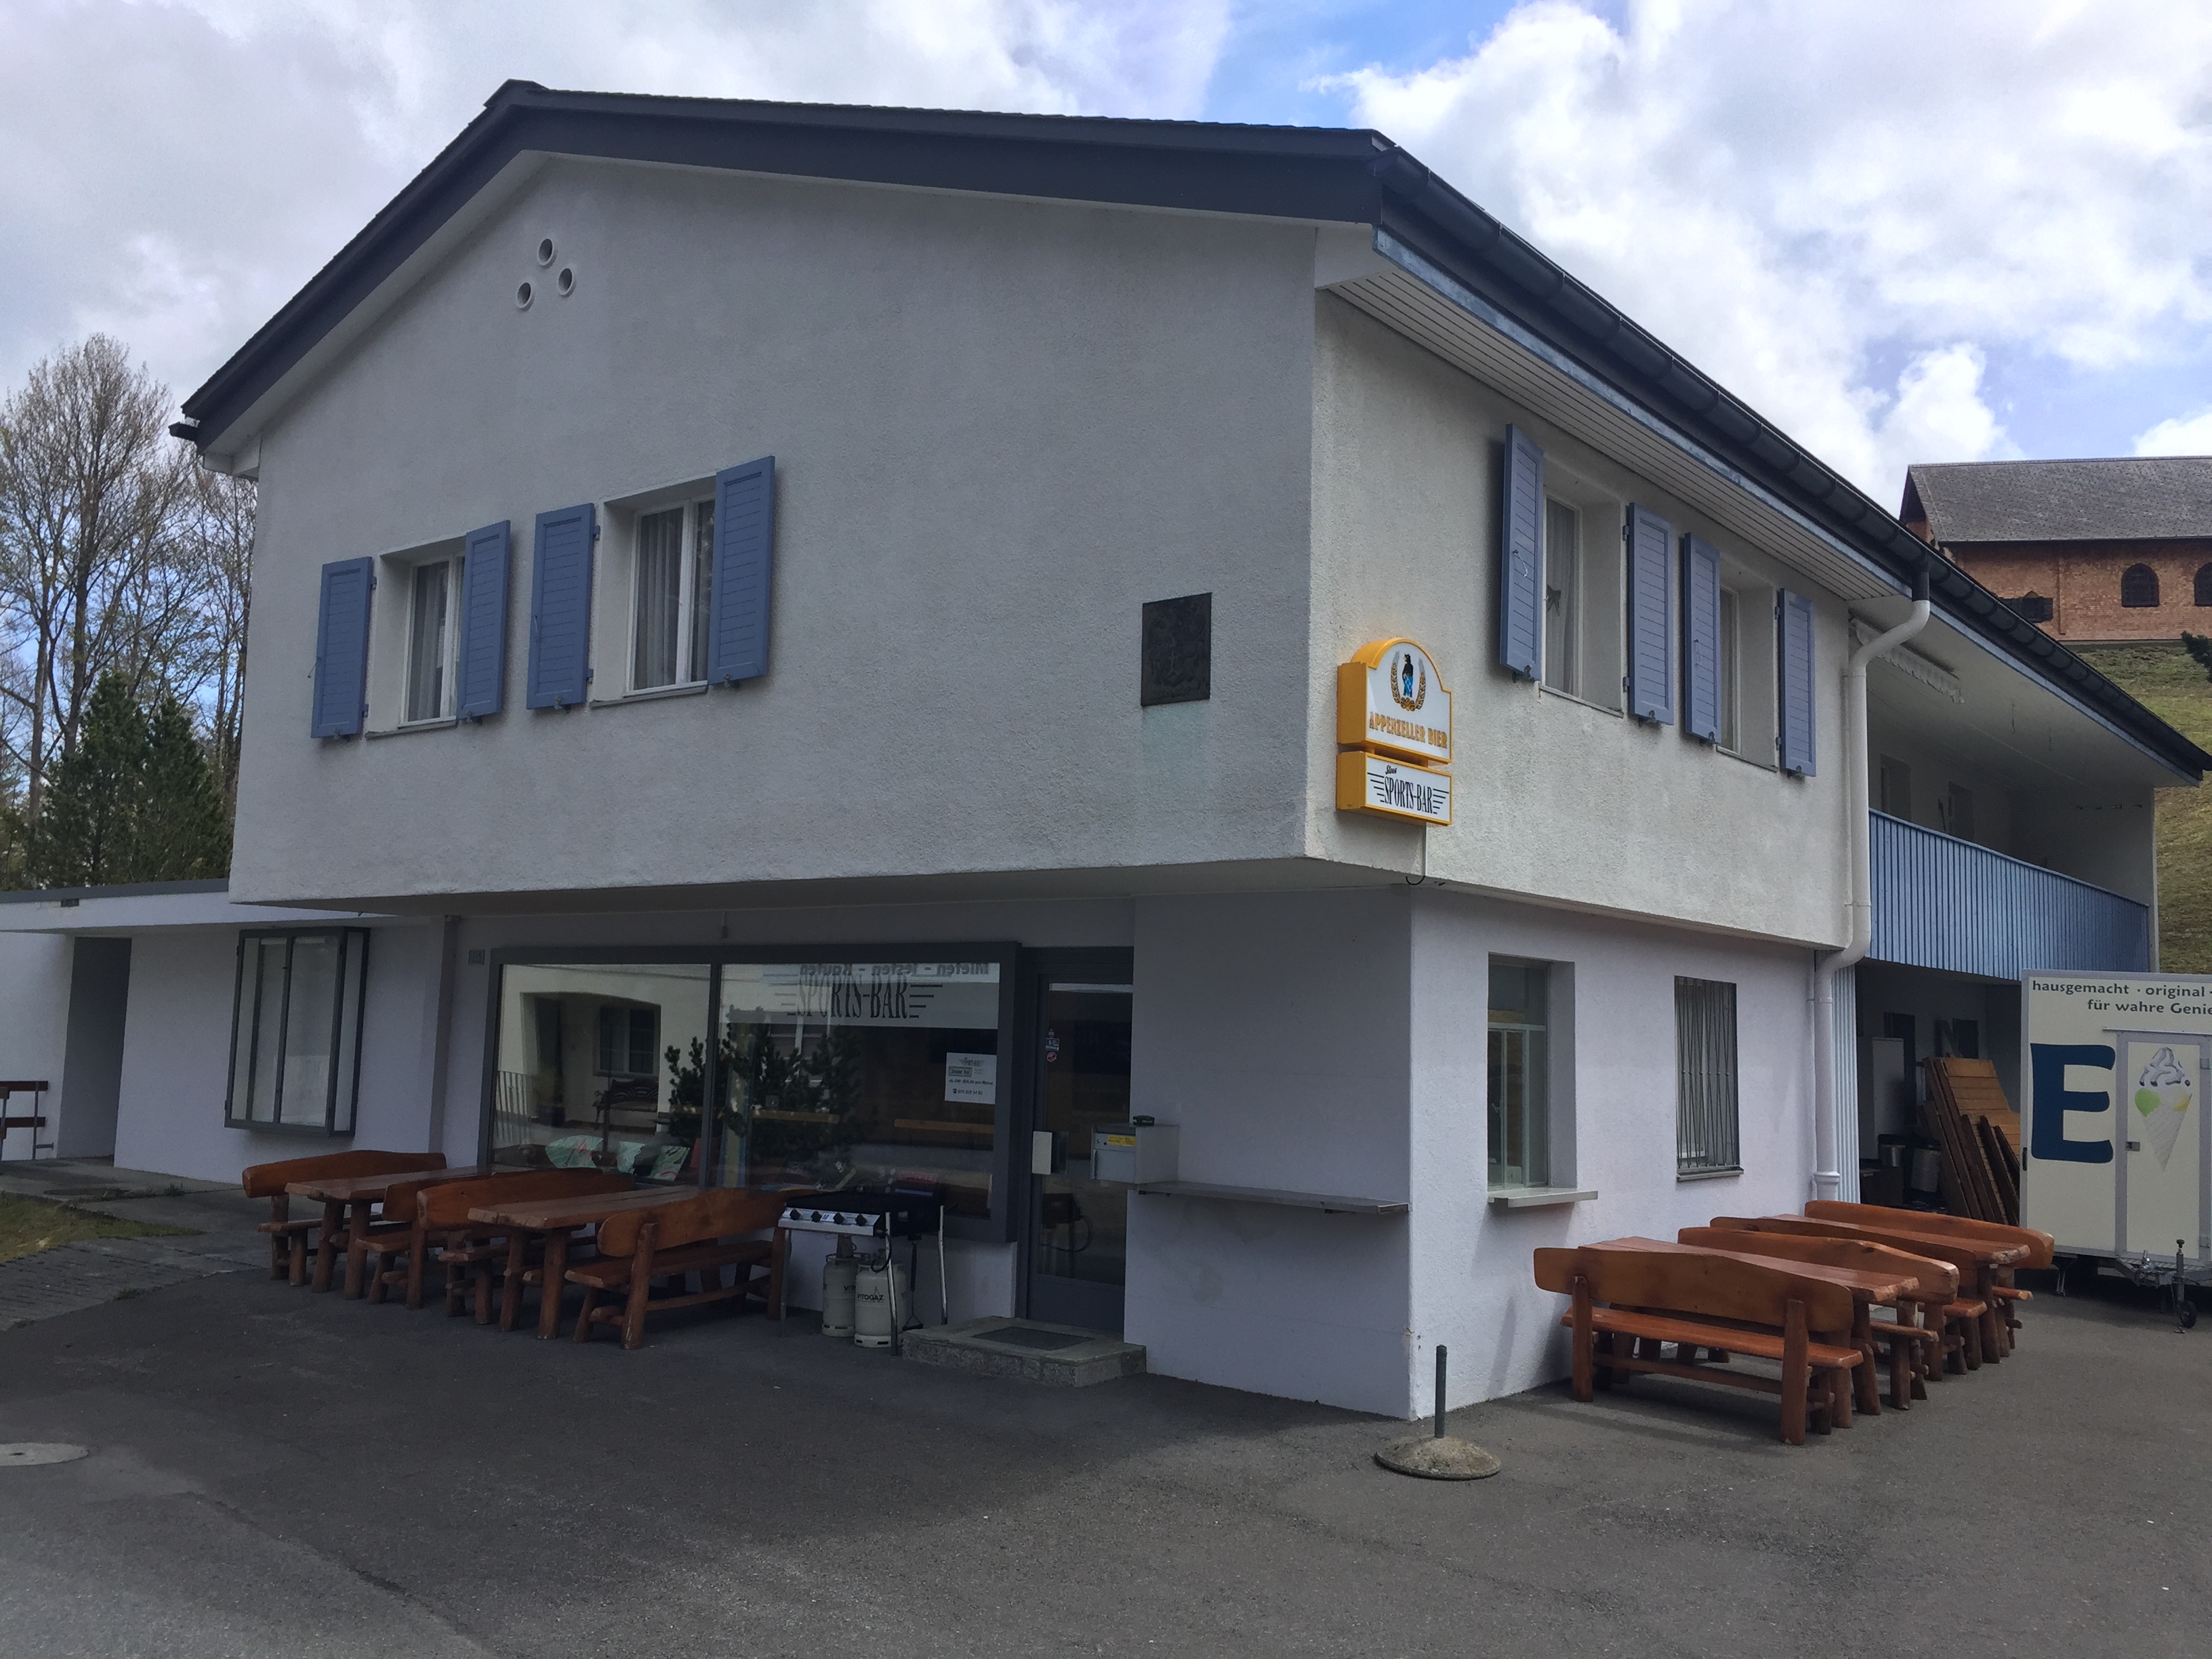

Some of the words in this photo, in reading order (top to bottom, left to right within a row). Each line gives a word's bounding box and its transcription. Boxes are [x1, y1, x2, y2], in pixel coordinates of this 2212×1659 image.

[1369, 712, 1425, 743] APPENZELLER
[1427, 727, 1448, 749] BIER
[1384, 776, 1433, 814] SPORTS-BAR
[797, 973, 907, 1019] SPORTS-BAR
[2032, 980, 2130, 995] hausgemacht
[2145, 985, 2205, 1000] original
[2087, 999, 2110, 1010] für
[2115, 1001, 2165, 1013] wahre
